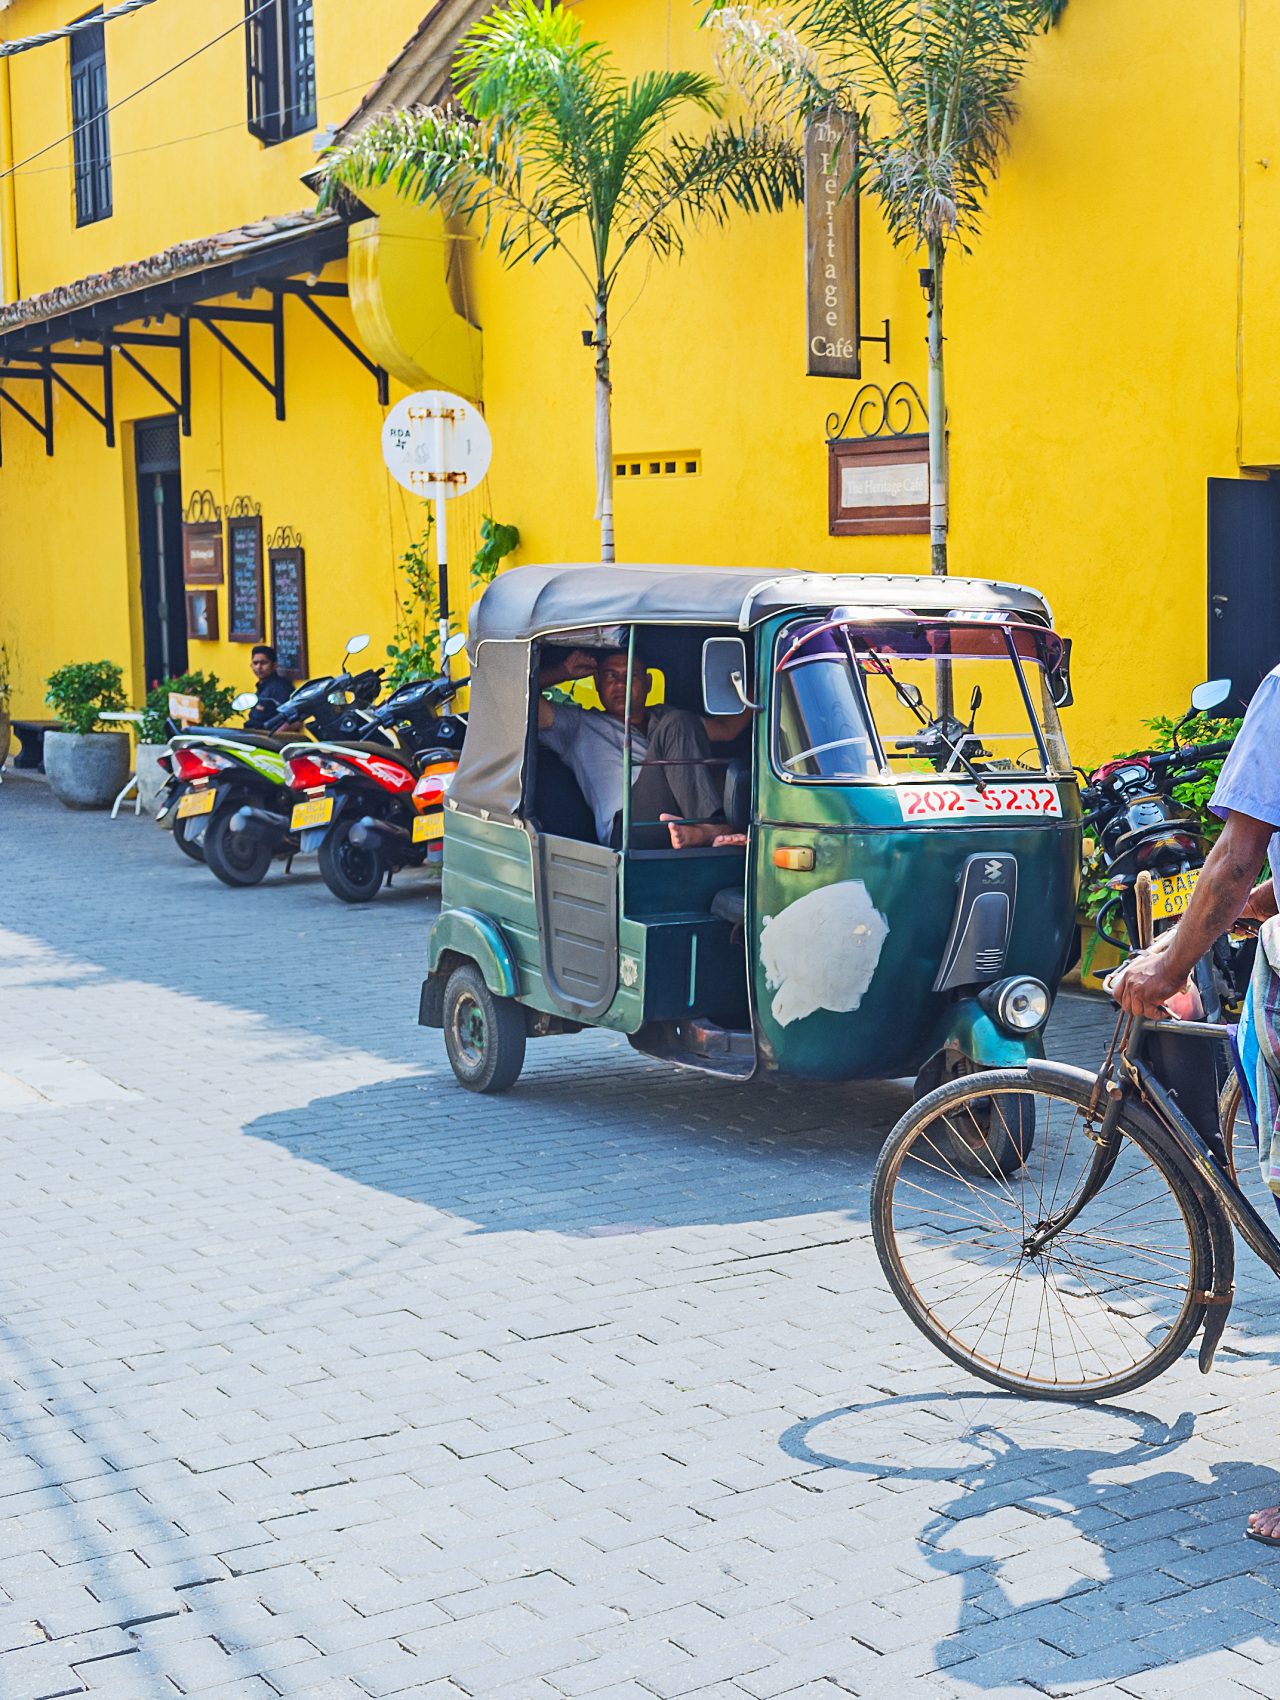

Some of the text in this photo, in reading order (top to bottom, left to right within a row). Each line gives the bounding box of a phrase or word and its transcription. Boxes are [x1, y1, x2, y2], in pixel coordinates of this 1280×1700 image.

[820, 152, 841, 327] Heritage
[810, 335, 853, 358] Café
[904, 788, 1057, 815] 202-5232
